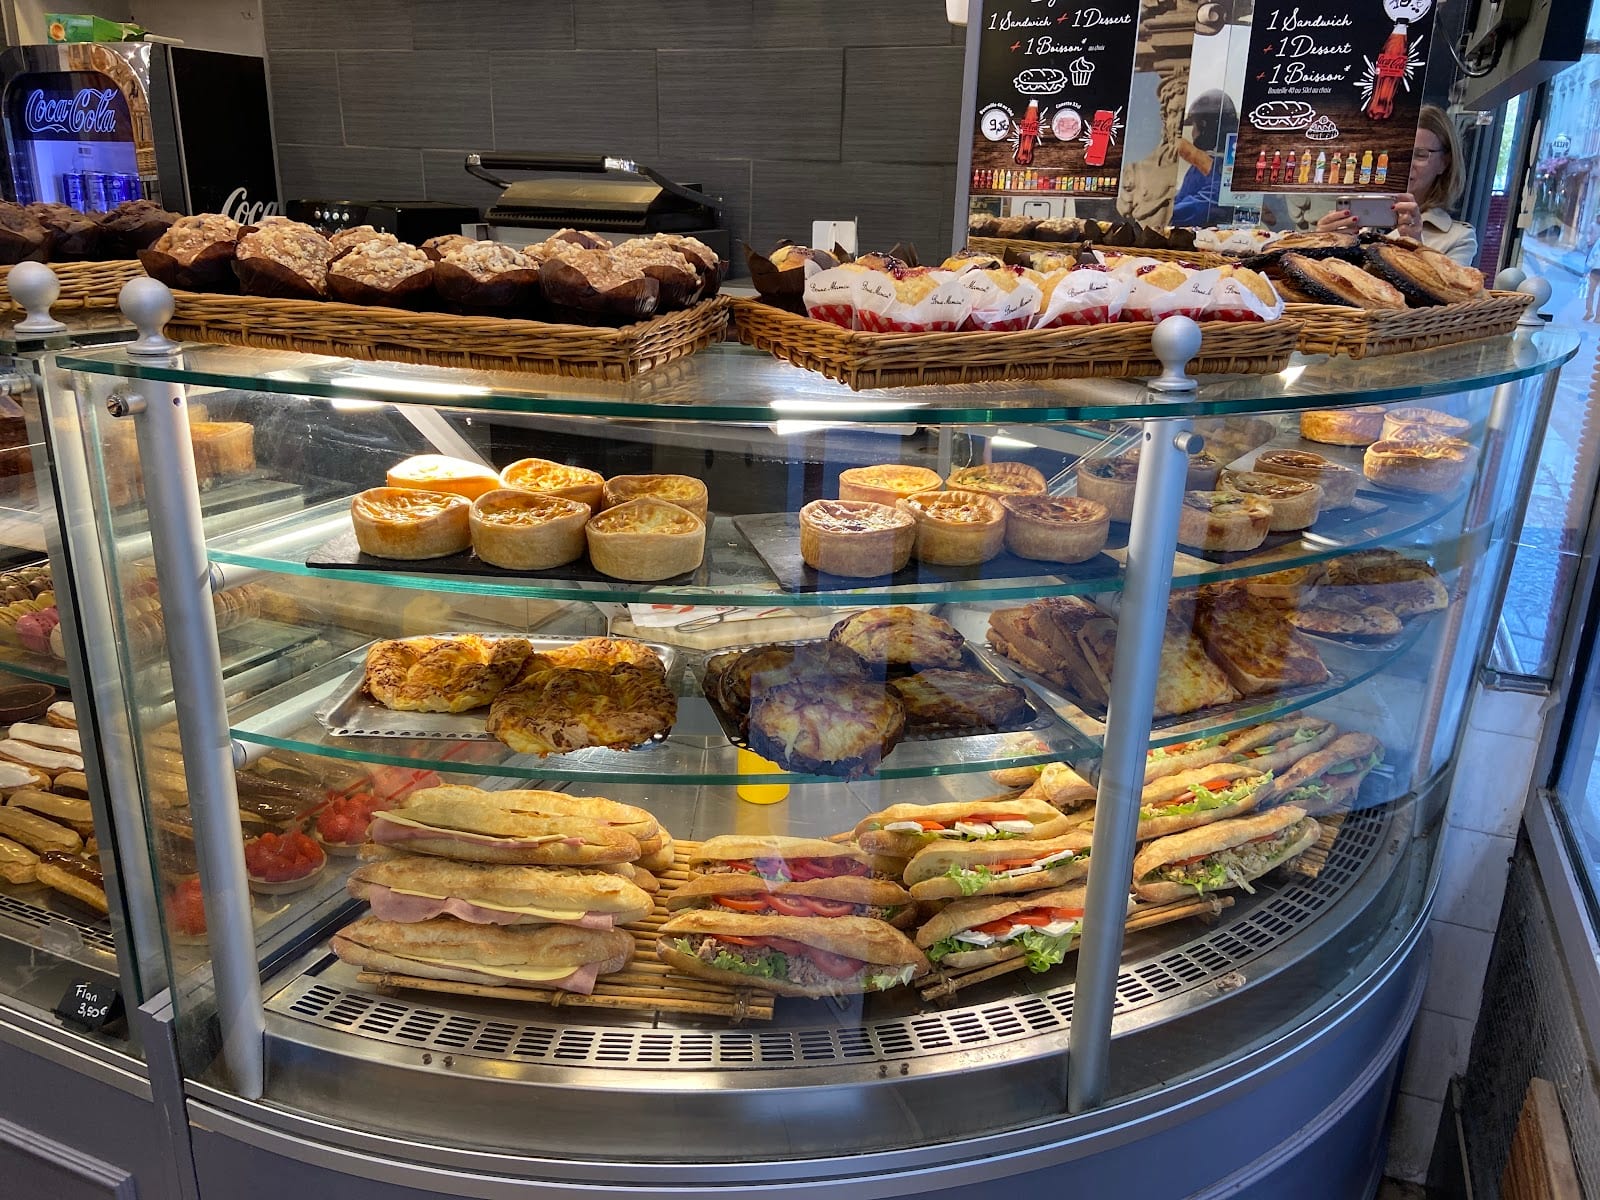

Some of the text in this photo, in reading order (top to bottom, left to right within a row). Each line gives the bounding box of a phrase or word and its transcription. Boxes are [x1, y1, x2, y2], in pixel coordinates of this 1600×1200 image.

[999, 11, 1052, 30] Sandwich
[1083, 8, 1132, 28] Dessert
[1281, 7, 1353, 32] Sandwich
[1289, 35, 1352, 58] Dessert
[25, 88, 118, 134] Coca-Cola
[75, 984, 98, 1002] Flan
